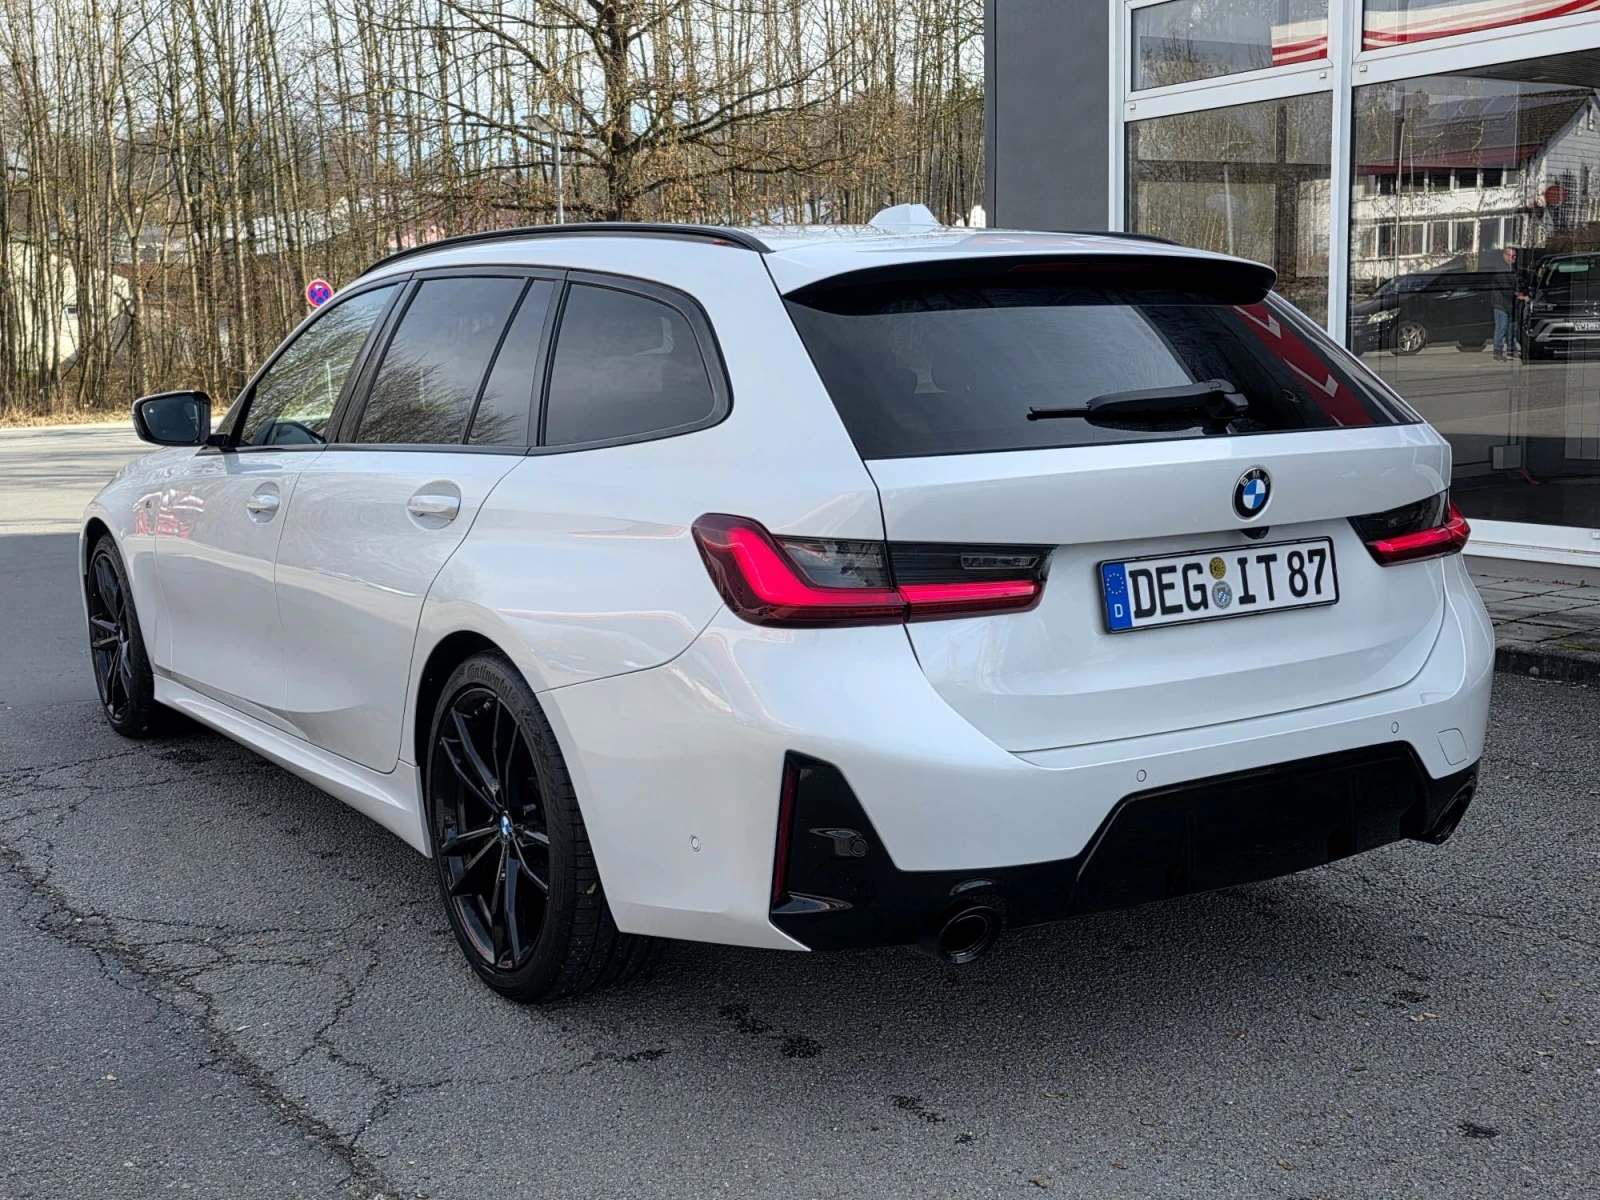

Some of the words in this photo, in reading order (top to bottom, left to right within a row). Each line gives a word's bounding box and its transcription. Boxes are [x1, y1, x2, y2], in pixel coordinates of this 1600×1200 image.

[1240, 470, 1270, 487] BMW
[1128, 562, 1209, 619] DEG
[1236, 553, 1278, 605] IT
[1287, 548, 1327, 598] 87
[1113, 603, 1124, 618] D
[467, 663, 513, 700] Continental
